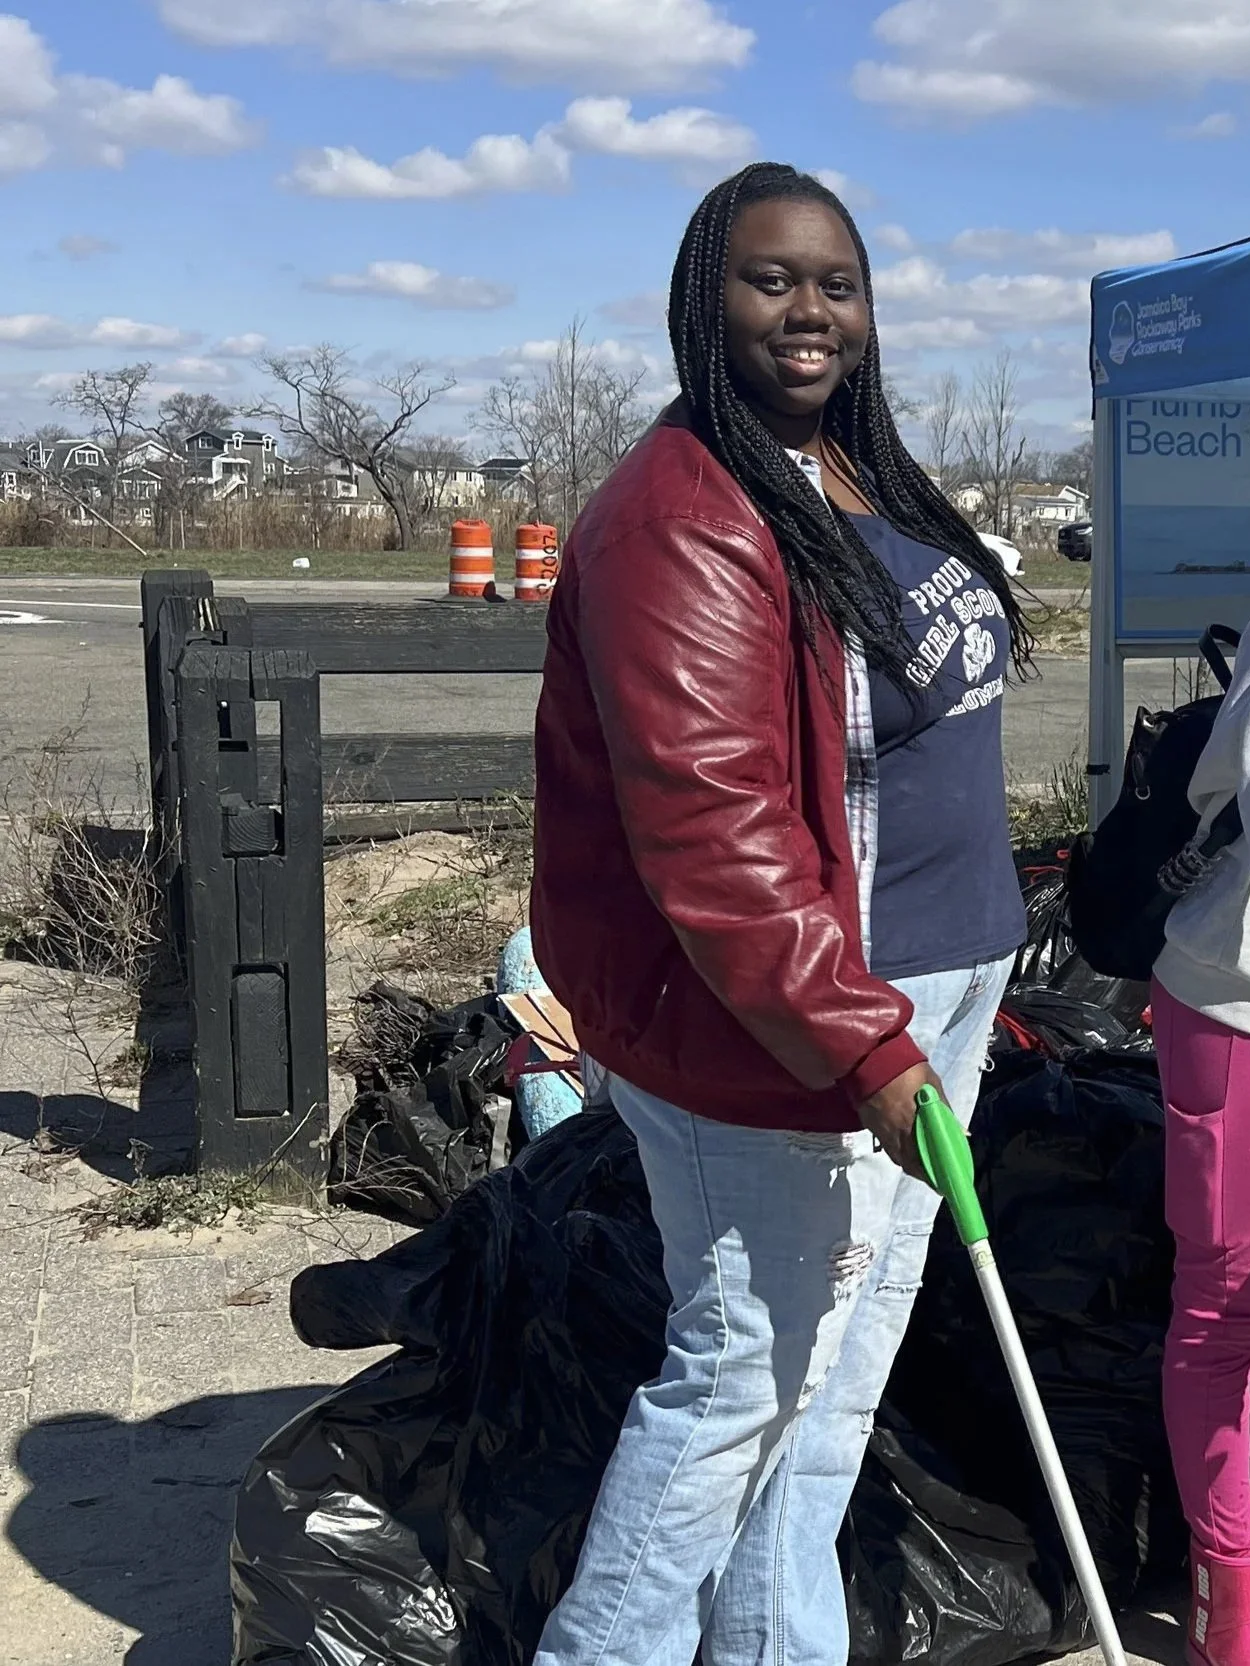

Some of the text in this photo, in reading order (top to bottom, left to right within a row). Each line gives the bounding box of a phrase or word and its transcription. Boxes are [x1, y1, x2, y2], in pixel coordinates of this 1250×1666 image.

[1136, 296, 1171, 320] Jamaica
[1170, 293, 1188, 314] Bay
[1177, 309, 1201, 332] Parks
[1126, 421, 1241, 458] Beach
[907, 556, 972, 615] PROUD
